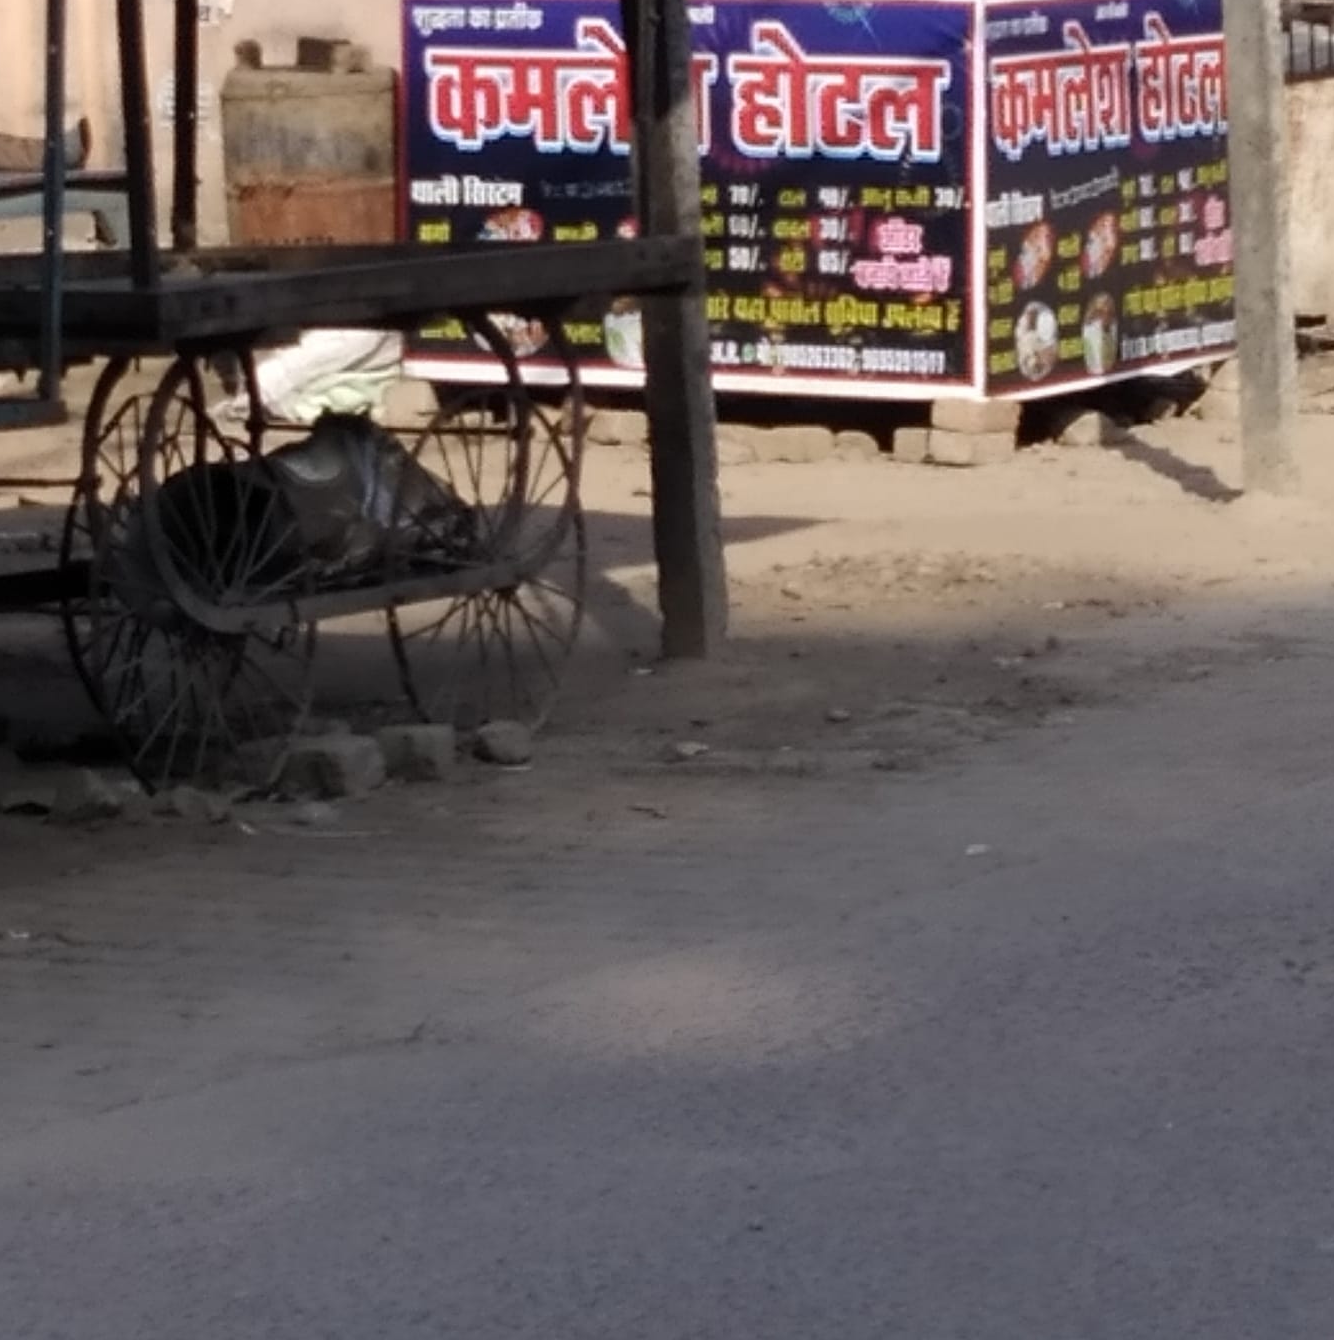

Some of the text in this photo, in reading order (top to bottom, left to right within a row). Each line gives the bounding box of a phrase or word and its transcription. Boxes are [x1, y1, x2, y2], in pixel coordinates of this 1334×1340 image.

[424, 17, 952, 164] कमले होटल
[990, 10, 1230, 162] कमलेश होटल
